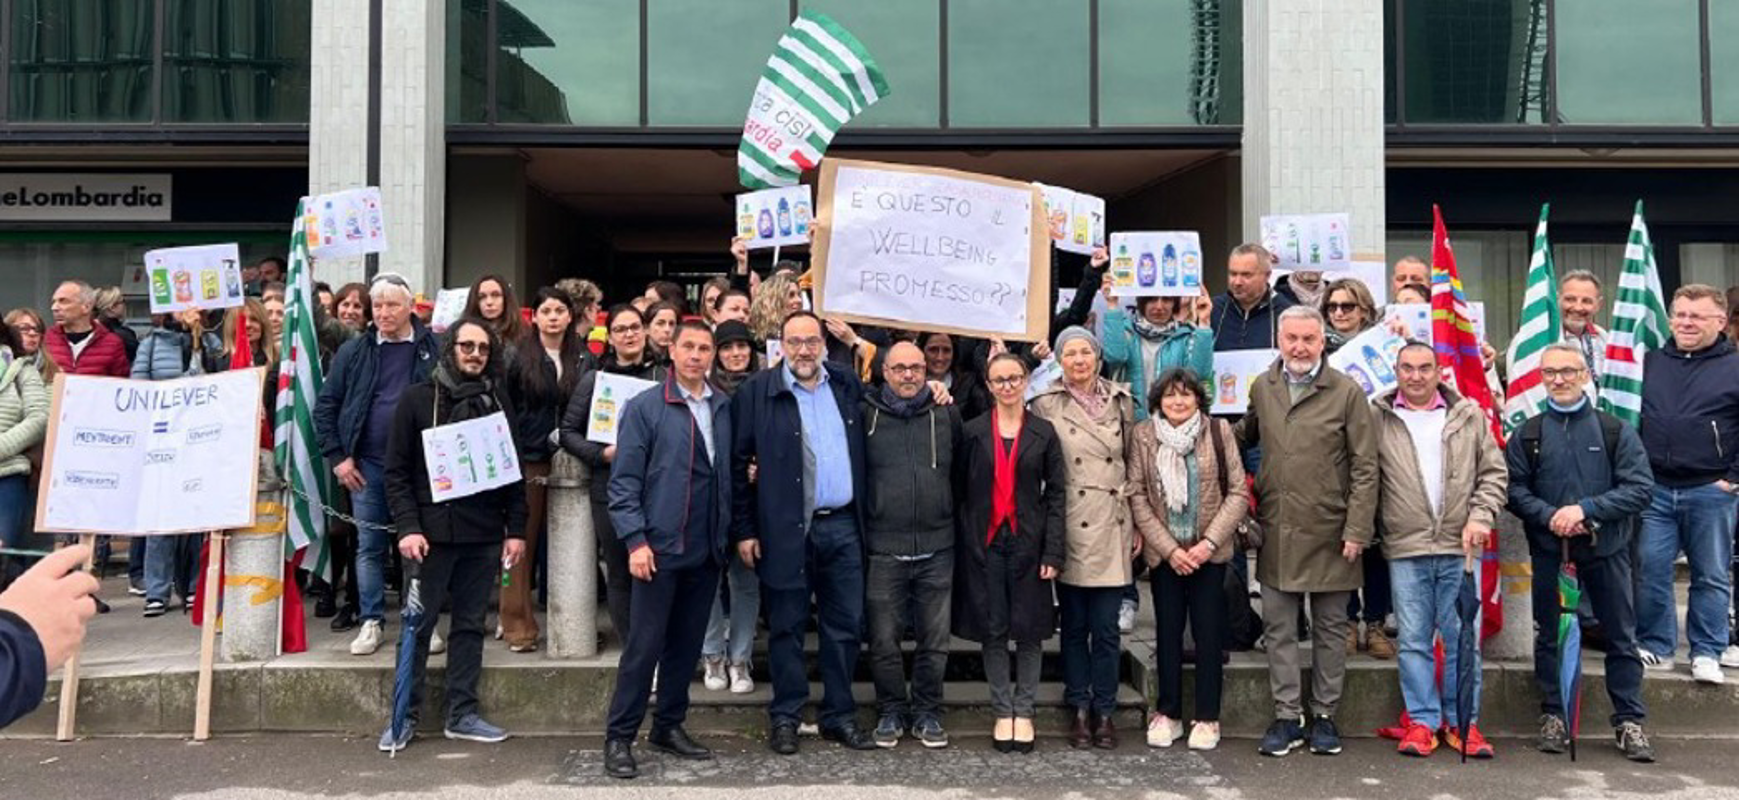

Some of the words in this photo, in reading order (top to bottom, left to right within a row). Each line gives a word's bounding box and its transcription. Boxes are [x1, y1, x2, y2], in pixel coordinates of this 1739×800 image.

[0, 185, 163, 207] eLombardia
[877, 191, 972, 218] QUESTO
[869, 227, 998, 266] WELLBEING
[115, 384, 219, 412] UNILEVER
